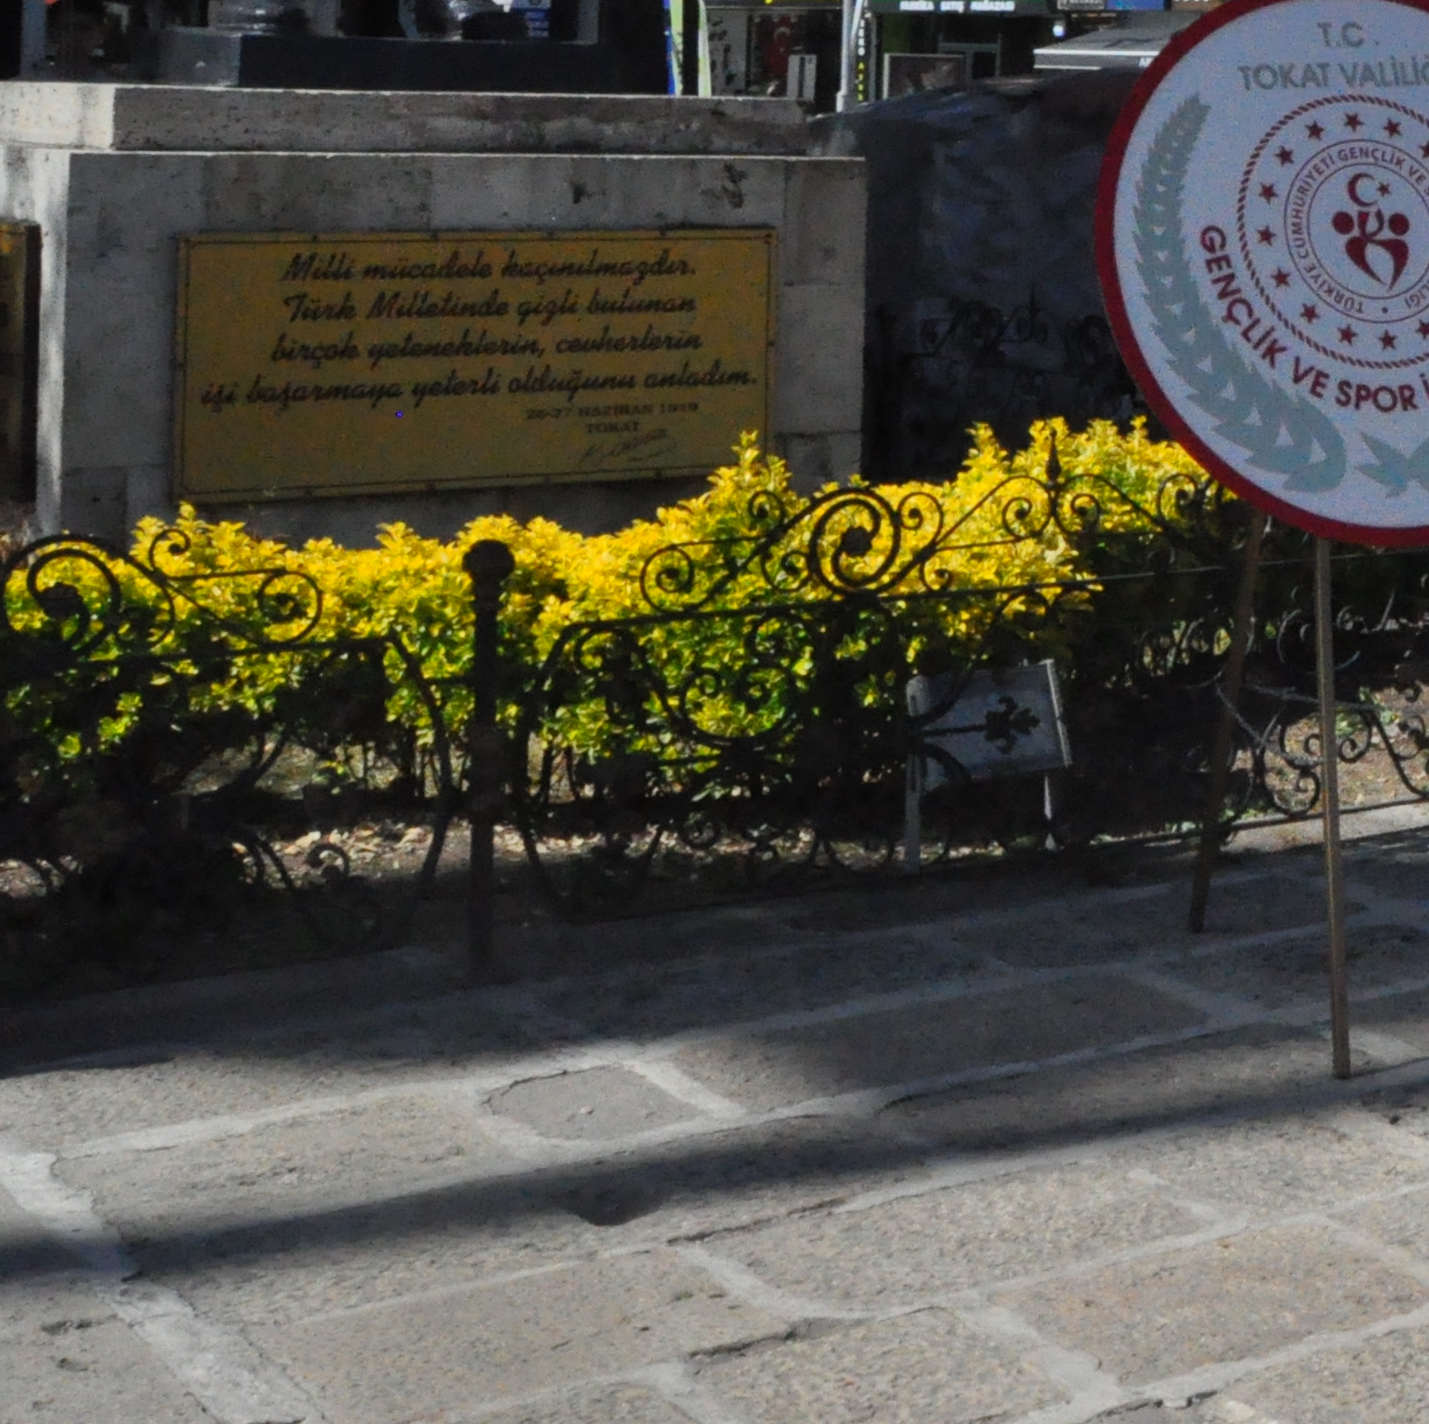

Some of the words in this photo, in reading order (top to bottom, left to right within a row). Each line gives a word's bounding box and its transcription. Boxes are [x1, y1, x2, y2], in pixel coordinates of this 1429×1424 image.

[1237, 61, 1331, 92] TOKAT
[1408, 165, 1426, 184] VE
[281, 251, 354, 281] Milli
[362, 250, 492, 280] mücadele
[283, 292, 357, 323] Türk
[366, 288, 509, 321] Milletinde
[517, 288, 579, 326] gizli
[587, 286, 697, 314] bulunan
[1200, 224, 1289, 369] GENÇLİK
[1291, 354, 1331, 399] VE
[1334, 378, 1419, 414] SPOR
[271, 328, 360, 369] birçok
[200, 380, 239, 413] işi
[246, 373, 404, 415] başarmaya
[411, 367, 501, 408] yeterli
[507, 363, 636, 402] olduğunu
